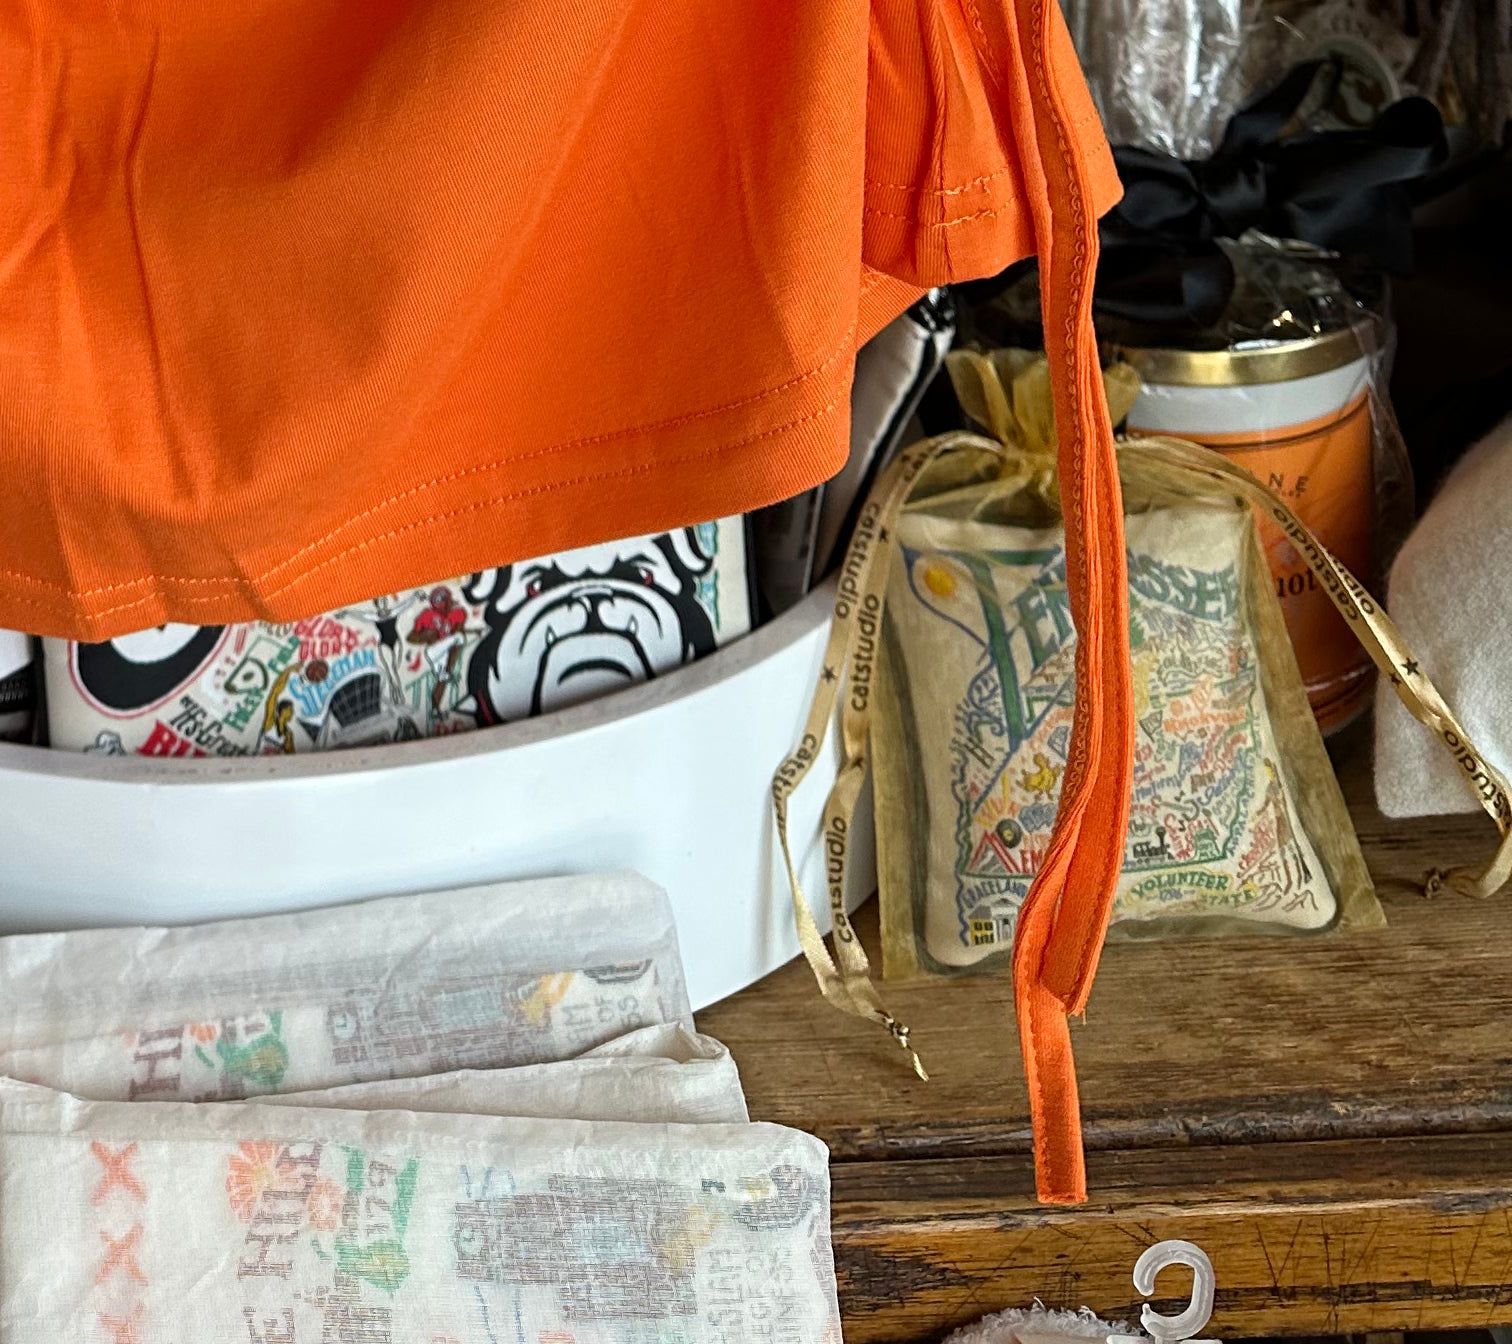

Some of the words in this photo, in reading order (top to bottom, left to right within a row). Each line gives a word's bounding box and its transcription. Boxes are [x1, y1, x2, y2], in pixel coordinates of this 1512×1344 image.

[835, 503, 880, 620] catstudio
[852, 593, 880, 712] catstudio
[825, 816, 863, 944] catstudio
[1131, 871, 1229, 896] VOLUNTEER
